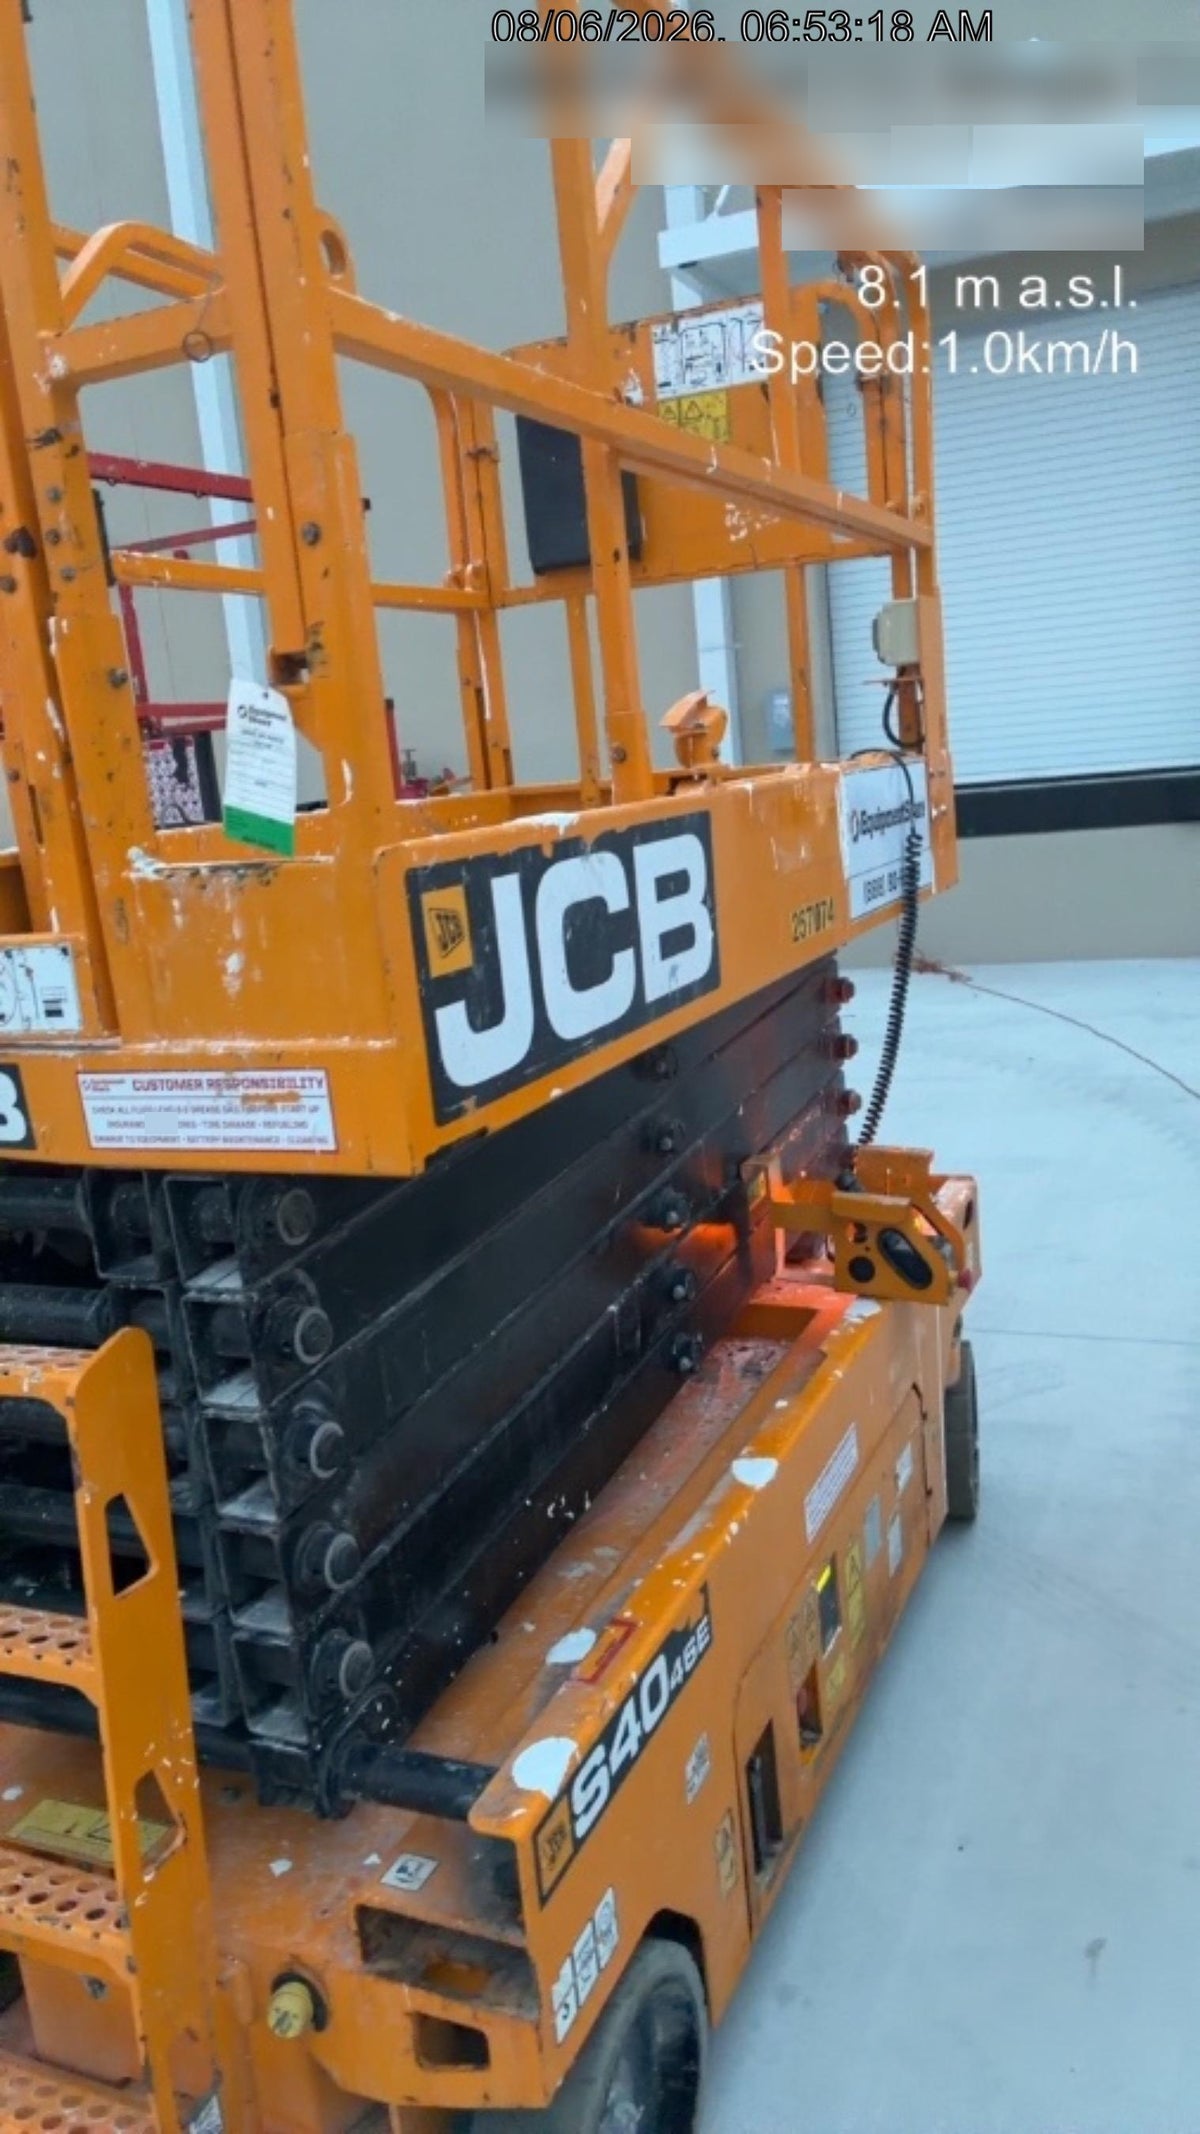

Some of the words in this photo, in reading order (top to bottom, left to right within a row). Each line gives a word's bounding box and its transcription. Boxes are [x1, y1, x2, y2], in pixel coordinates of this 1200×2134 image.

[435, 833, 714, 1088] JCB
[132, 1078, 203, 1091] CUSTOMER
[206, 1076, 323, 1090] RESPONSIBILITY
